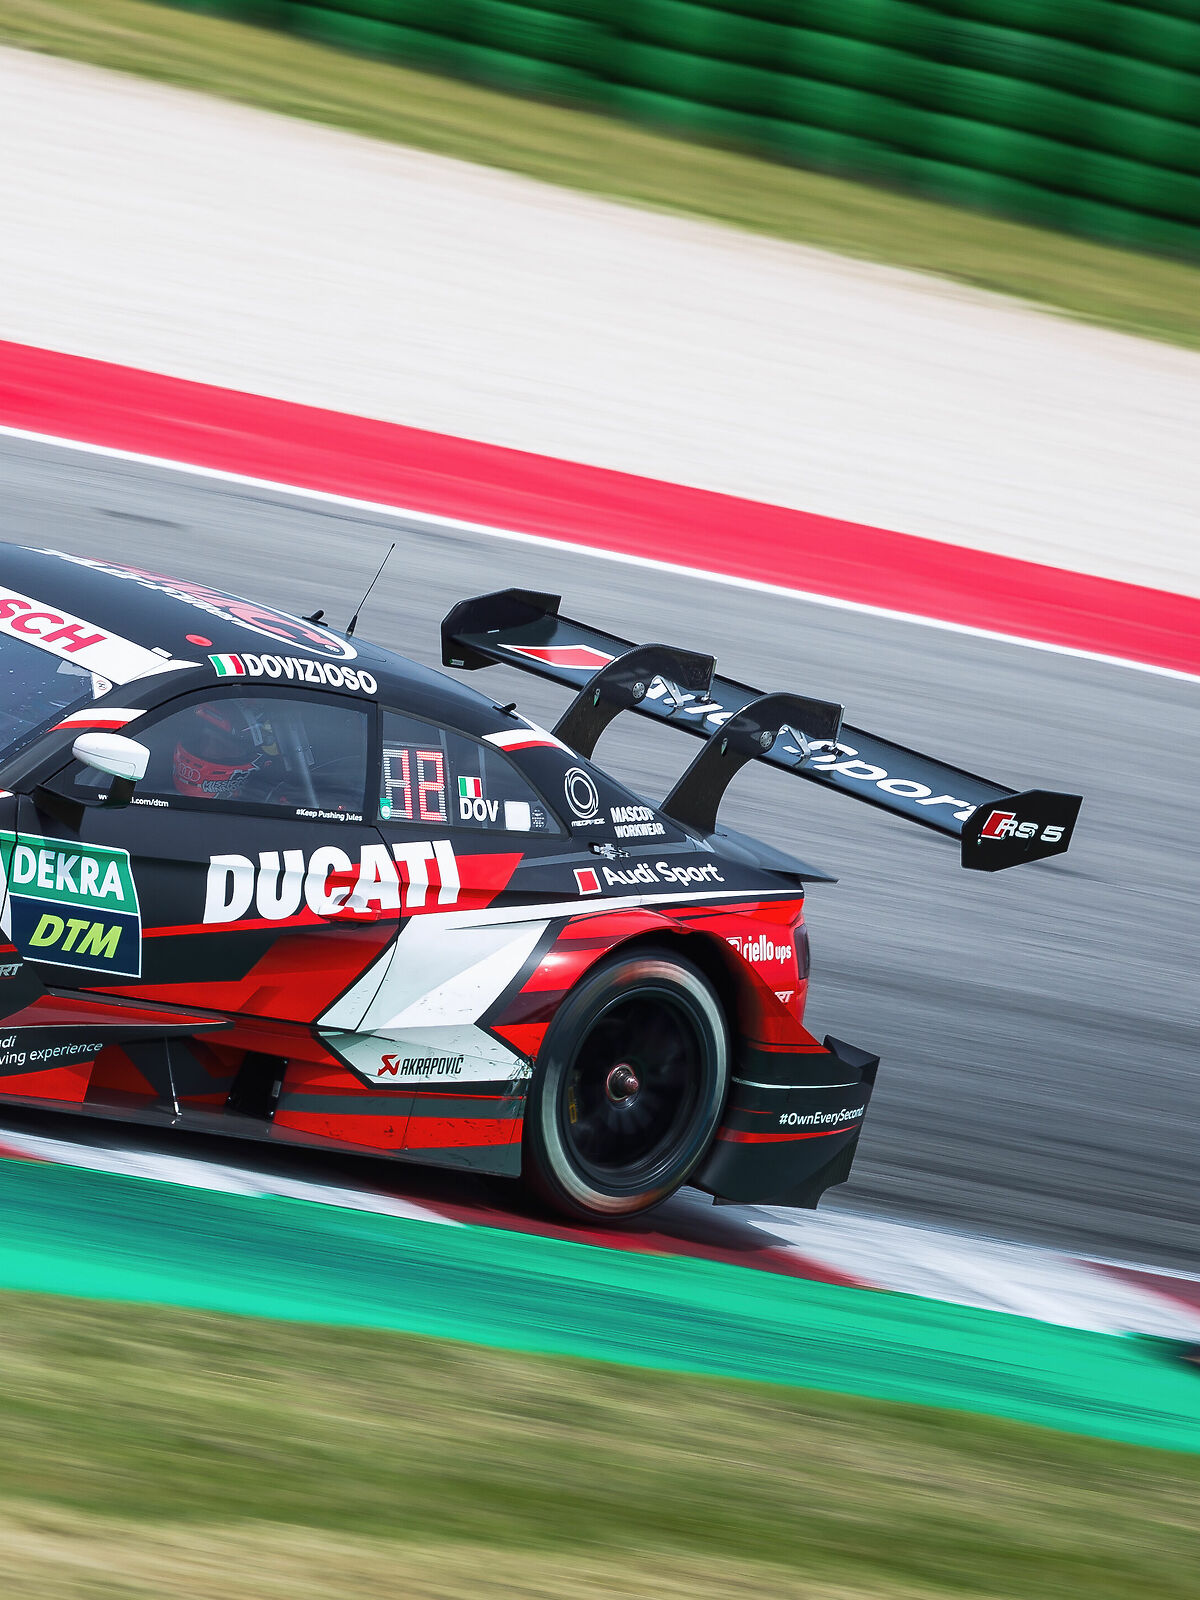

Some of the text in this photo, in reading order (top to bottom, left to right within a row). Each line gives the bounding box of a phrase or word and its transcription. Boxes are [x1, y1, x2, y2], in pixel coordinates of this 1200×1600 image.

[245, 654, 378, 695] DOVIZIOSO
[296, 808, 363, 822] #Keep Pushing Jules
[460, 798, 499, 822] DOV
[610, 805, 655, 823] MASCOT
[614, 822, 666, 838] WORKWEAR
[996, 818, 1066, 842] RS 5
[13, 845, 125, 901] DEKRA
[202, 839, 461, 924] DUCATI
[603, 861, 725, 886] Audi Sport
[28, 913, 123, 959] DTM
[743, 934, 792, 964] riello ups
[29, 1041, 104, 1063] experience
[779, 1104, 865, 1126] #OwnEverySecond
